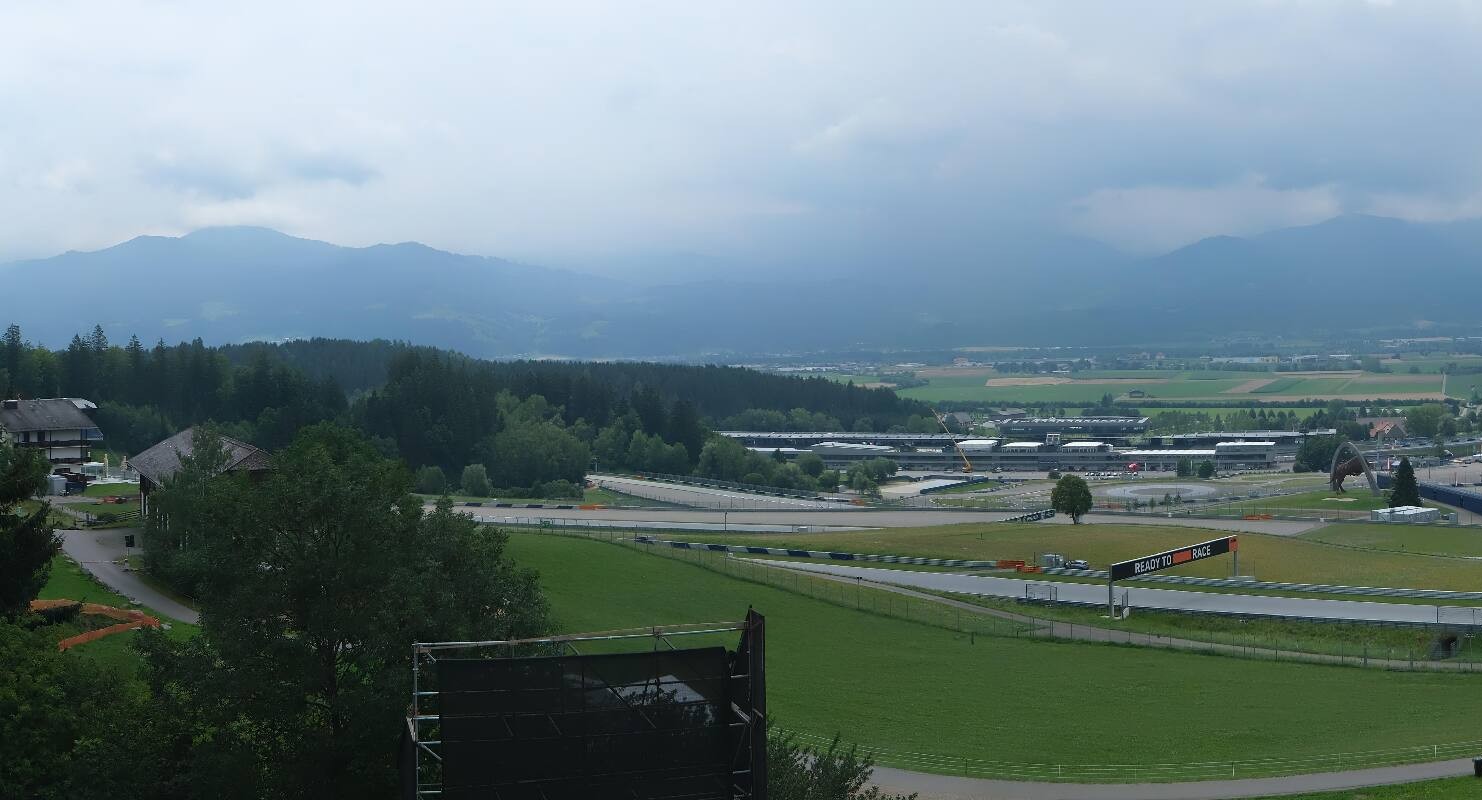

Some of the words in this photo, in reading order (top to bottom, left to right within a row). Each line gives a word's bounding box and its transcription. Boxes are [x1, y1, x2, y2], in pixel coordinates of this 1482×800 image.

[1134, 557, 1161, 573] READY
[1162, 554, 1172, 567] TO
[1192, 545, 1211, 559] RACE
